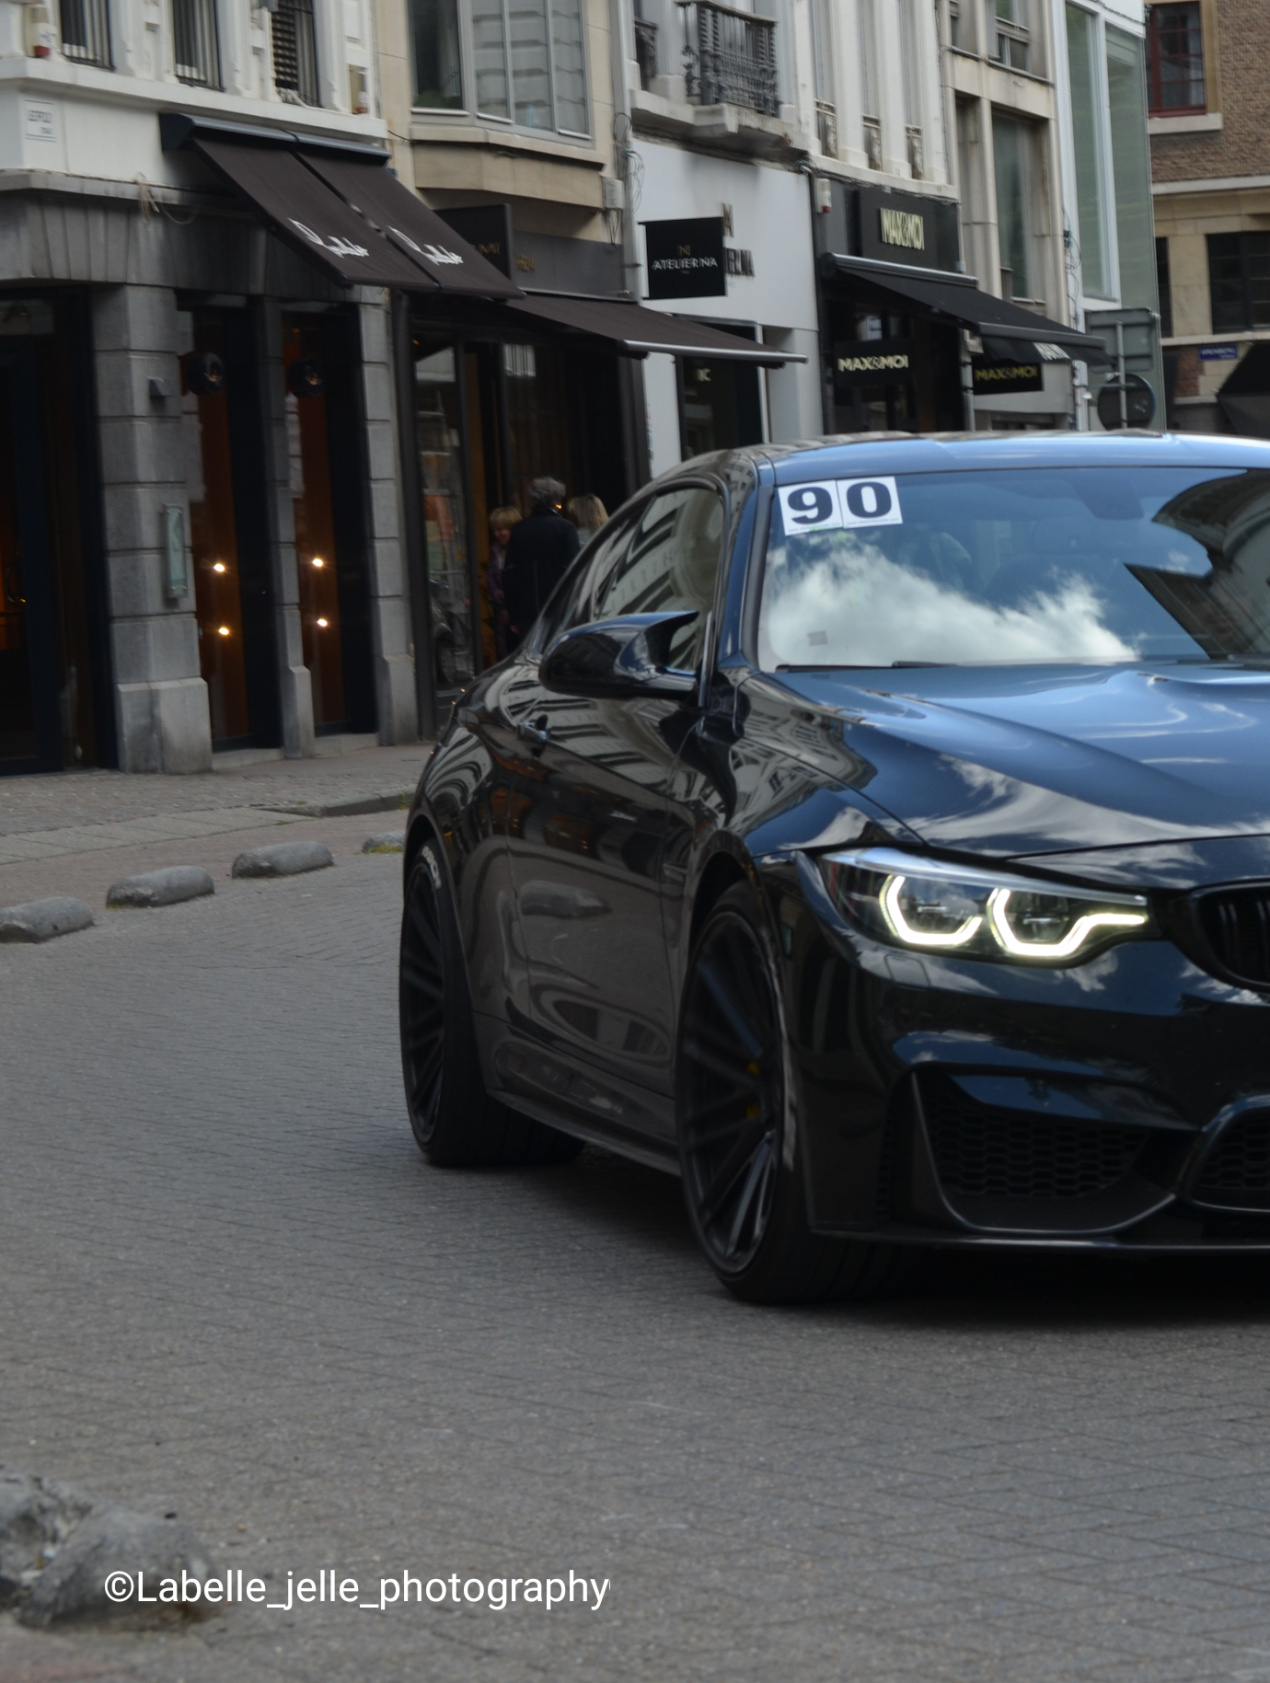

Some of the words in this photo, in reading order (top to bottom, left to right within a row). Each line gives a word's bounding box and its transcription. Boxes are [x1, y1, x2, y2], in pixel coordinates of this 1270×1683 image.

[881, 207, 925, 250] MAX&MOI
[837, 354, 910, 372] MAX&MOI
[974, 365, 1038, 381] MAX&MOI
[786, 481, 892, 525] 90
